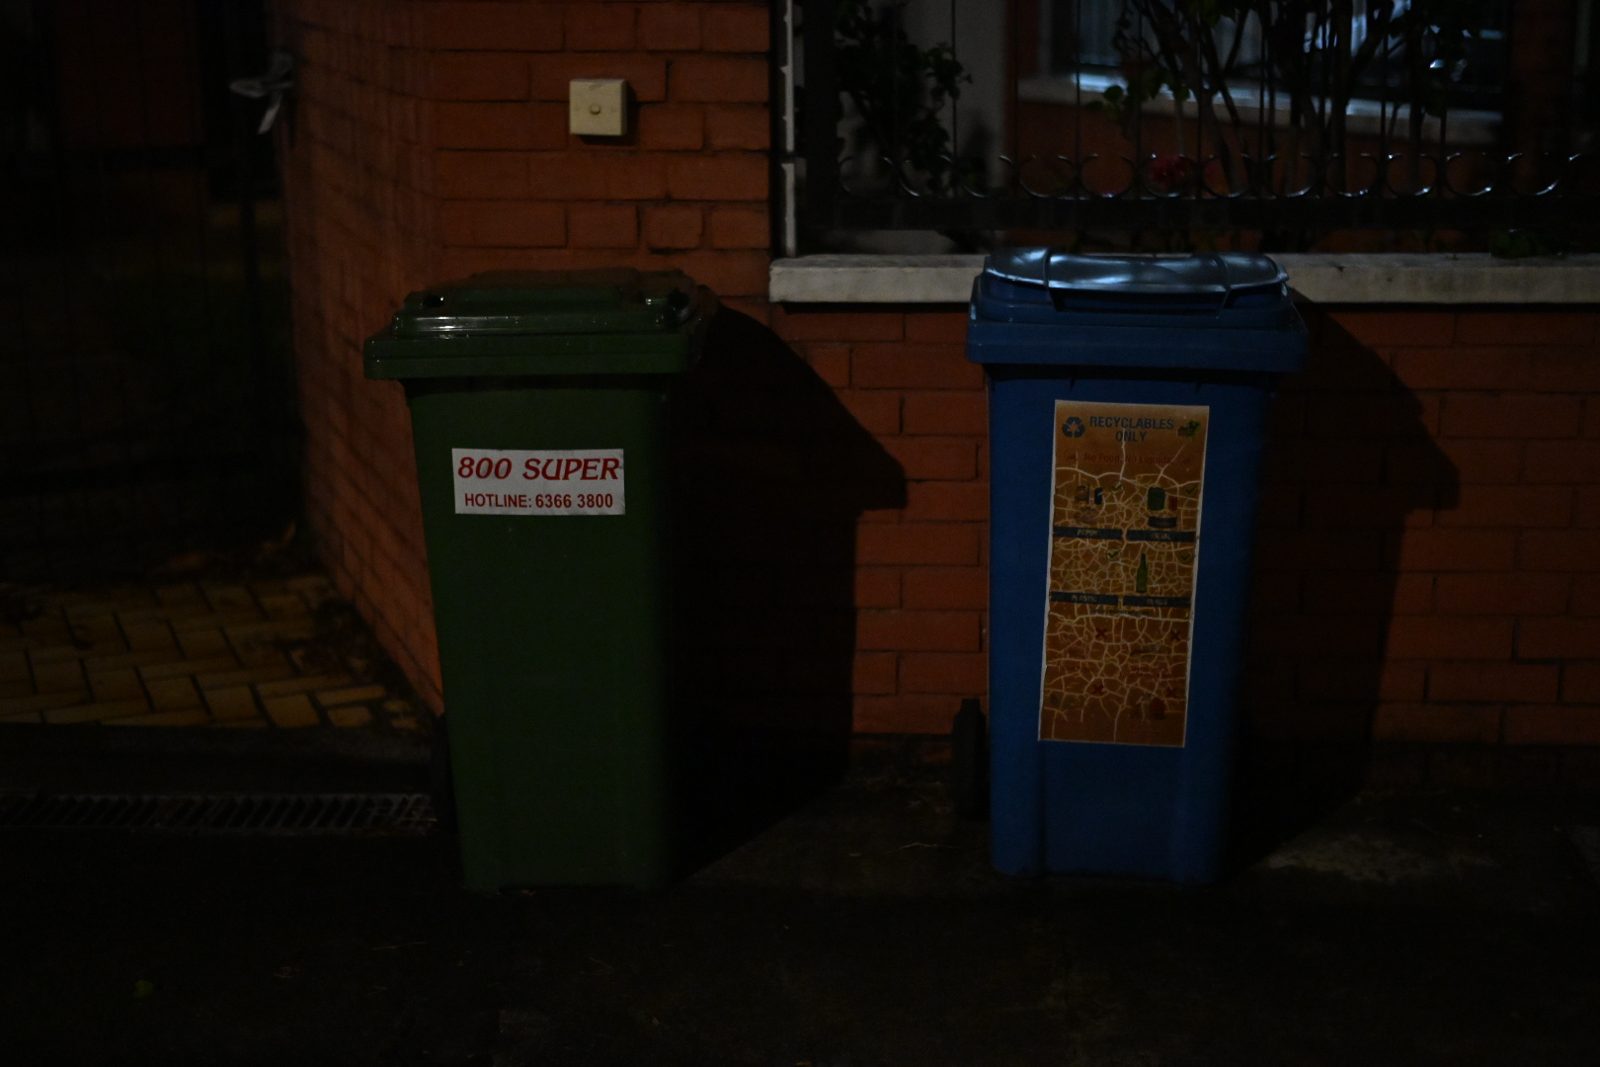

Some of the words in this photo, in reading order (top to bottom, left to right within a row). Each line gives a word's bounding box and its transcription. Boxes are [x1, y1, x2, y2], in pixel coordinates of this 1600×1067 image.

[1089, 416, 1173, 430] RECYCLABLES
[1115, 431, 1147, 442] ONLY
[458, 457, 512, 479] 800
[522, 458, 620, 481] SUPER
[465, 493, 532, 508] HOTLINE:
[535, 494, 572, 508] 6366
[577, 494, 613, 508] 3800
